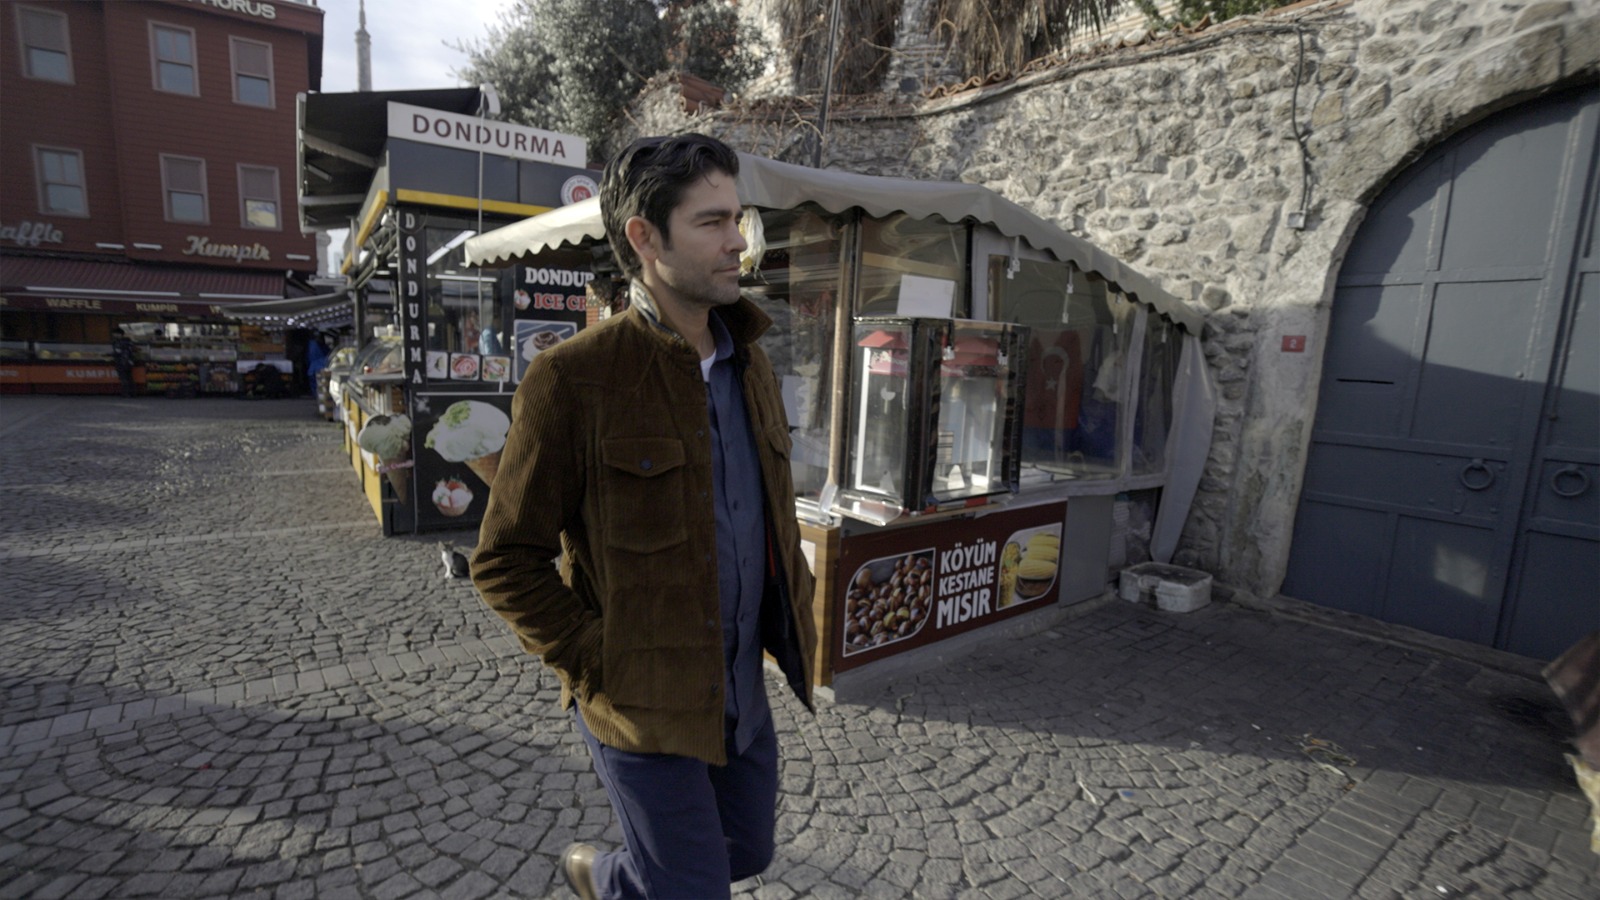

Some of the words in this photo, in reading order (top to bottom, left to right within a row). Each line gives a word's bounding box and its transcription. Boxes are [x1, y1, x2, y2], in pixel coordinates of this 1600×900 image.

[412, 113, 566, 159] DONDURMA
[45, 298, 102, 310] WAFFLE
[405, 212, 422, 384] DONDURMA
[533, 292, 565, 310] ICE
[940, 538, 996, 574] KÖYÜM
[938, 565, 995, 597] KESTANE
[936, 587, 991, 630] MISIR
